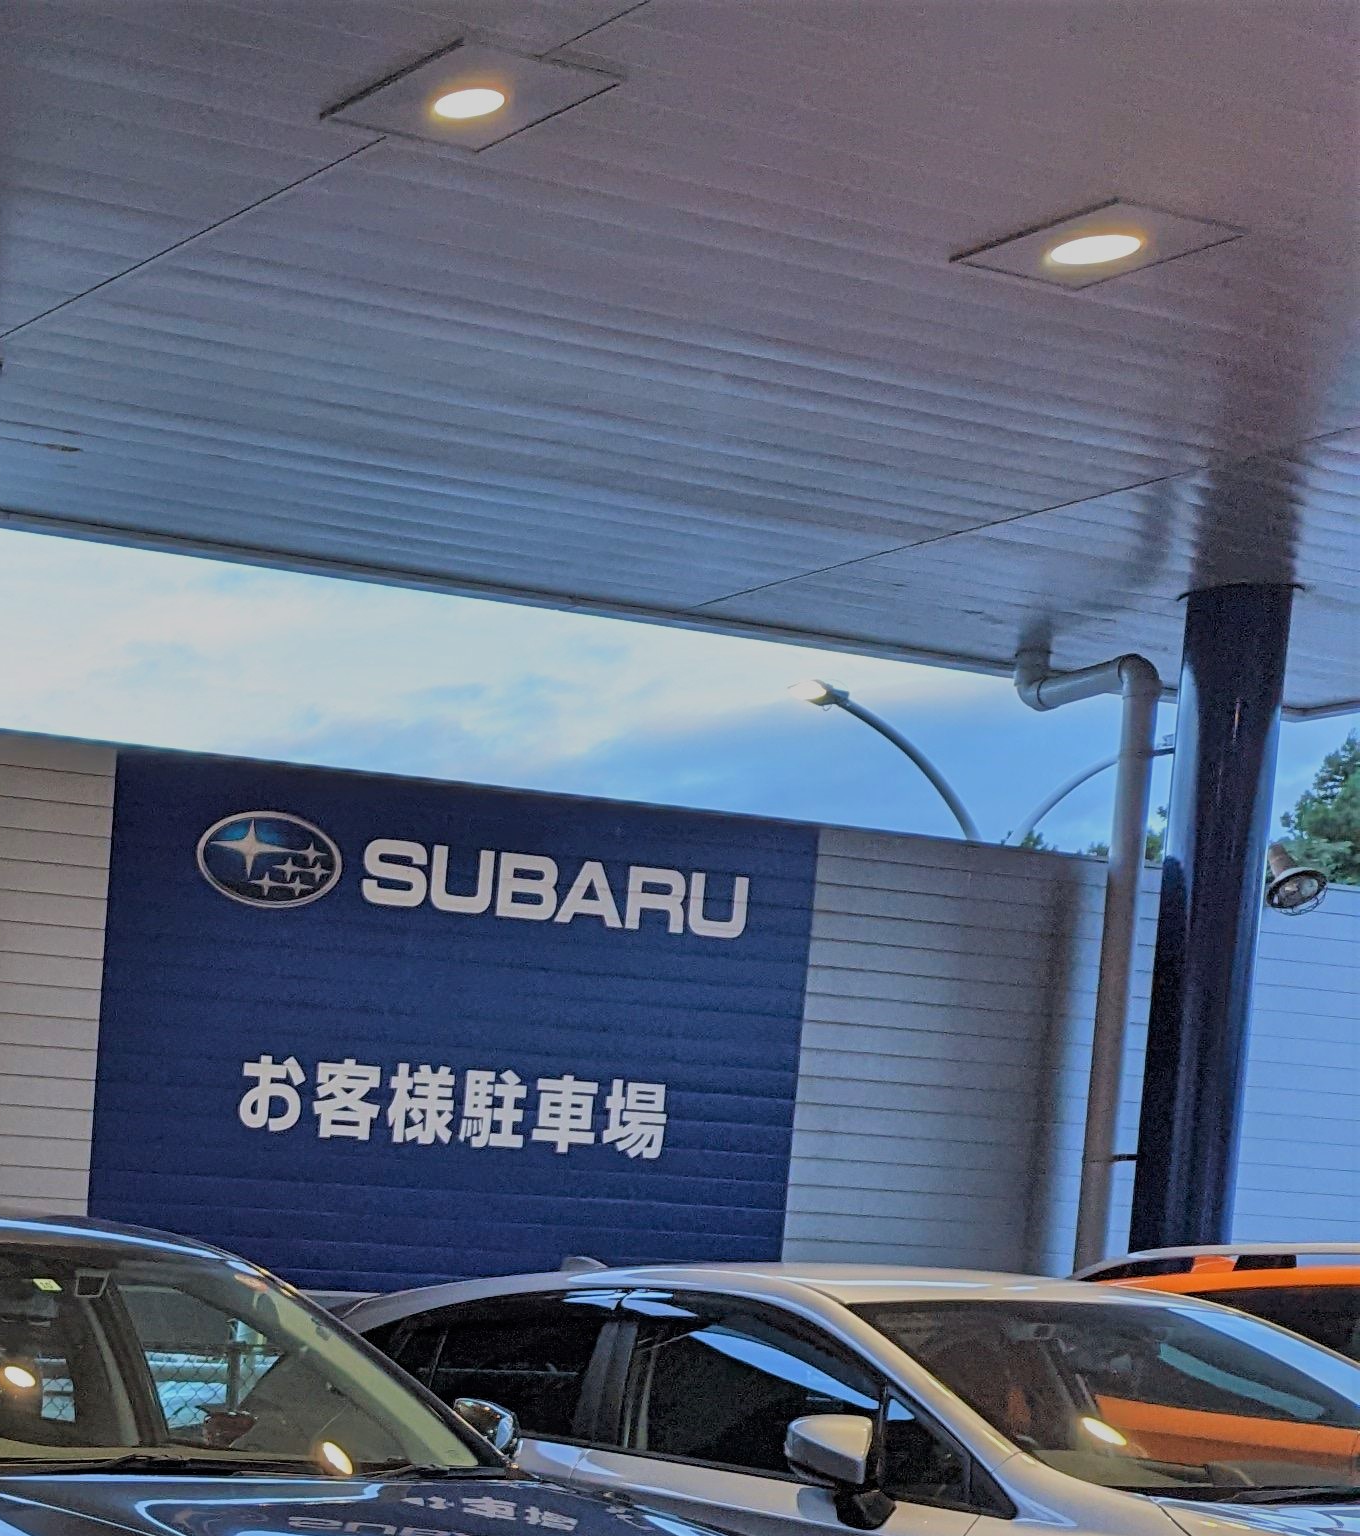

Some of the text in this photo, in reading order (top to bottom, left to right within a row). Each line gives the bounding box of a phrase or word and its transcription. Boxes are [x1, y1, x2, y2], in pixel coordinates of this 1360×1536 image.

[361, 838, 749, 939] SUBARU
[238, 1055, 668, 1159] お客様駐車場
